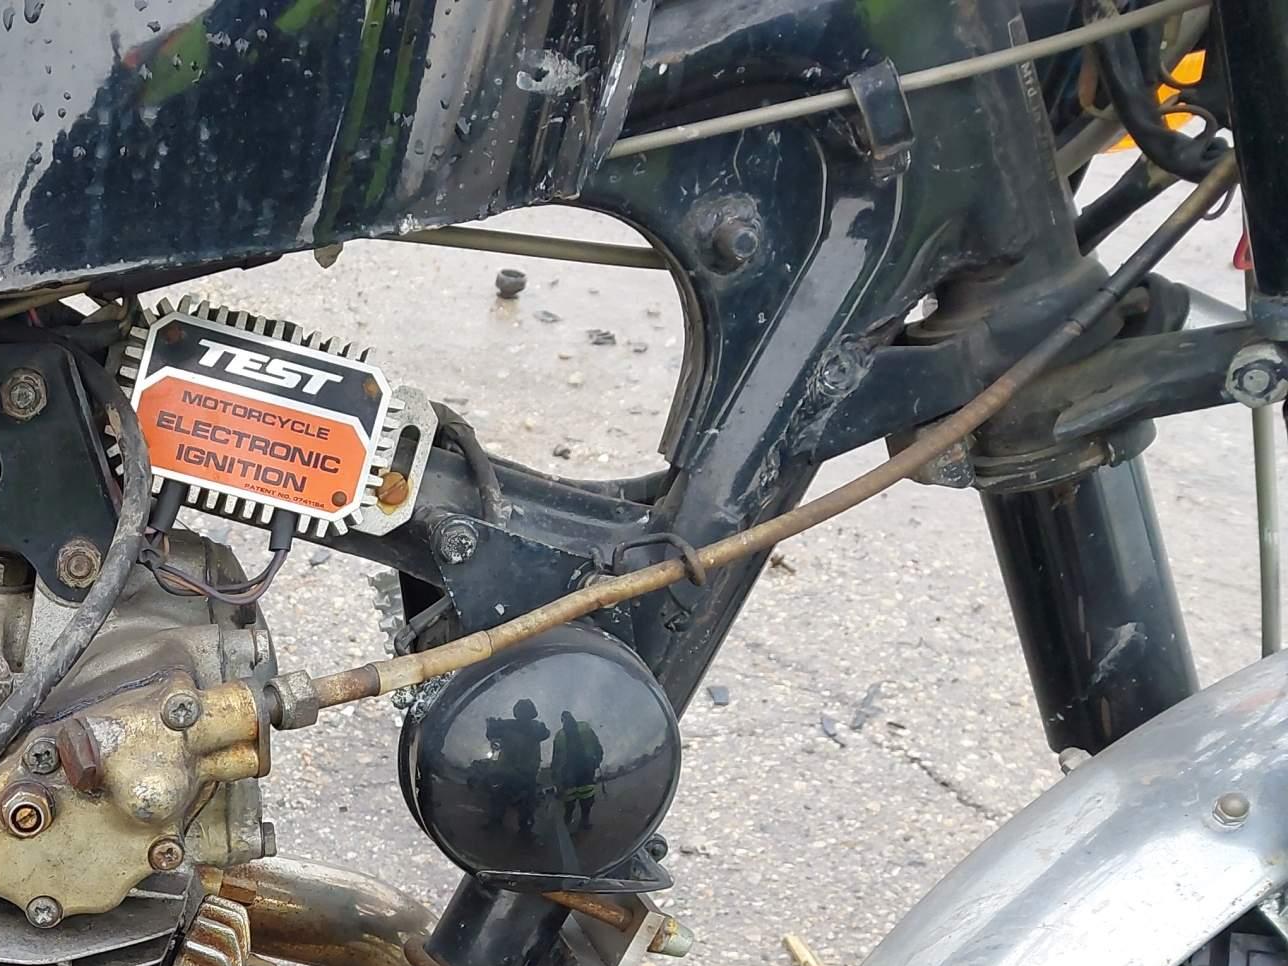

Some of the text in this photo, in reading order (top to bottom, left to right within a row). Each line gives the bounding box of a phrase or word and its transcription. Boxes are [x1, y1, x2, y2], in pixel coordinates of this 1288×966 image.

[198, 338, 344, 396] TEST
[181, 390, 331, 441] MOTORCYCLE
[156, 410, 341, 474] ELECTRONIC
[175, 443, 308, 493] IGNITION
[244, 483, 275, 496] PATENT
[277, 492, 292, 501] NO.
